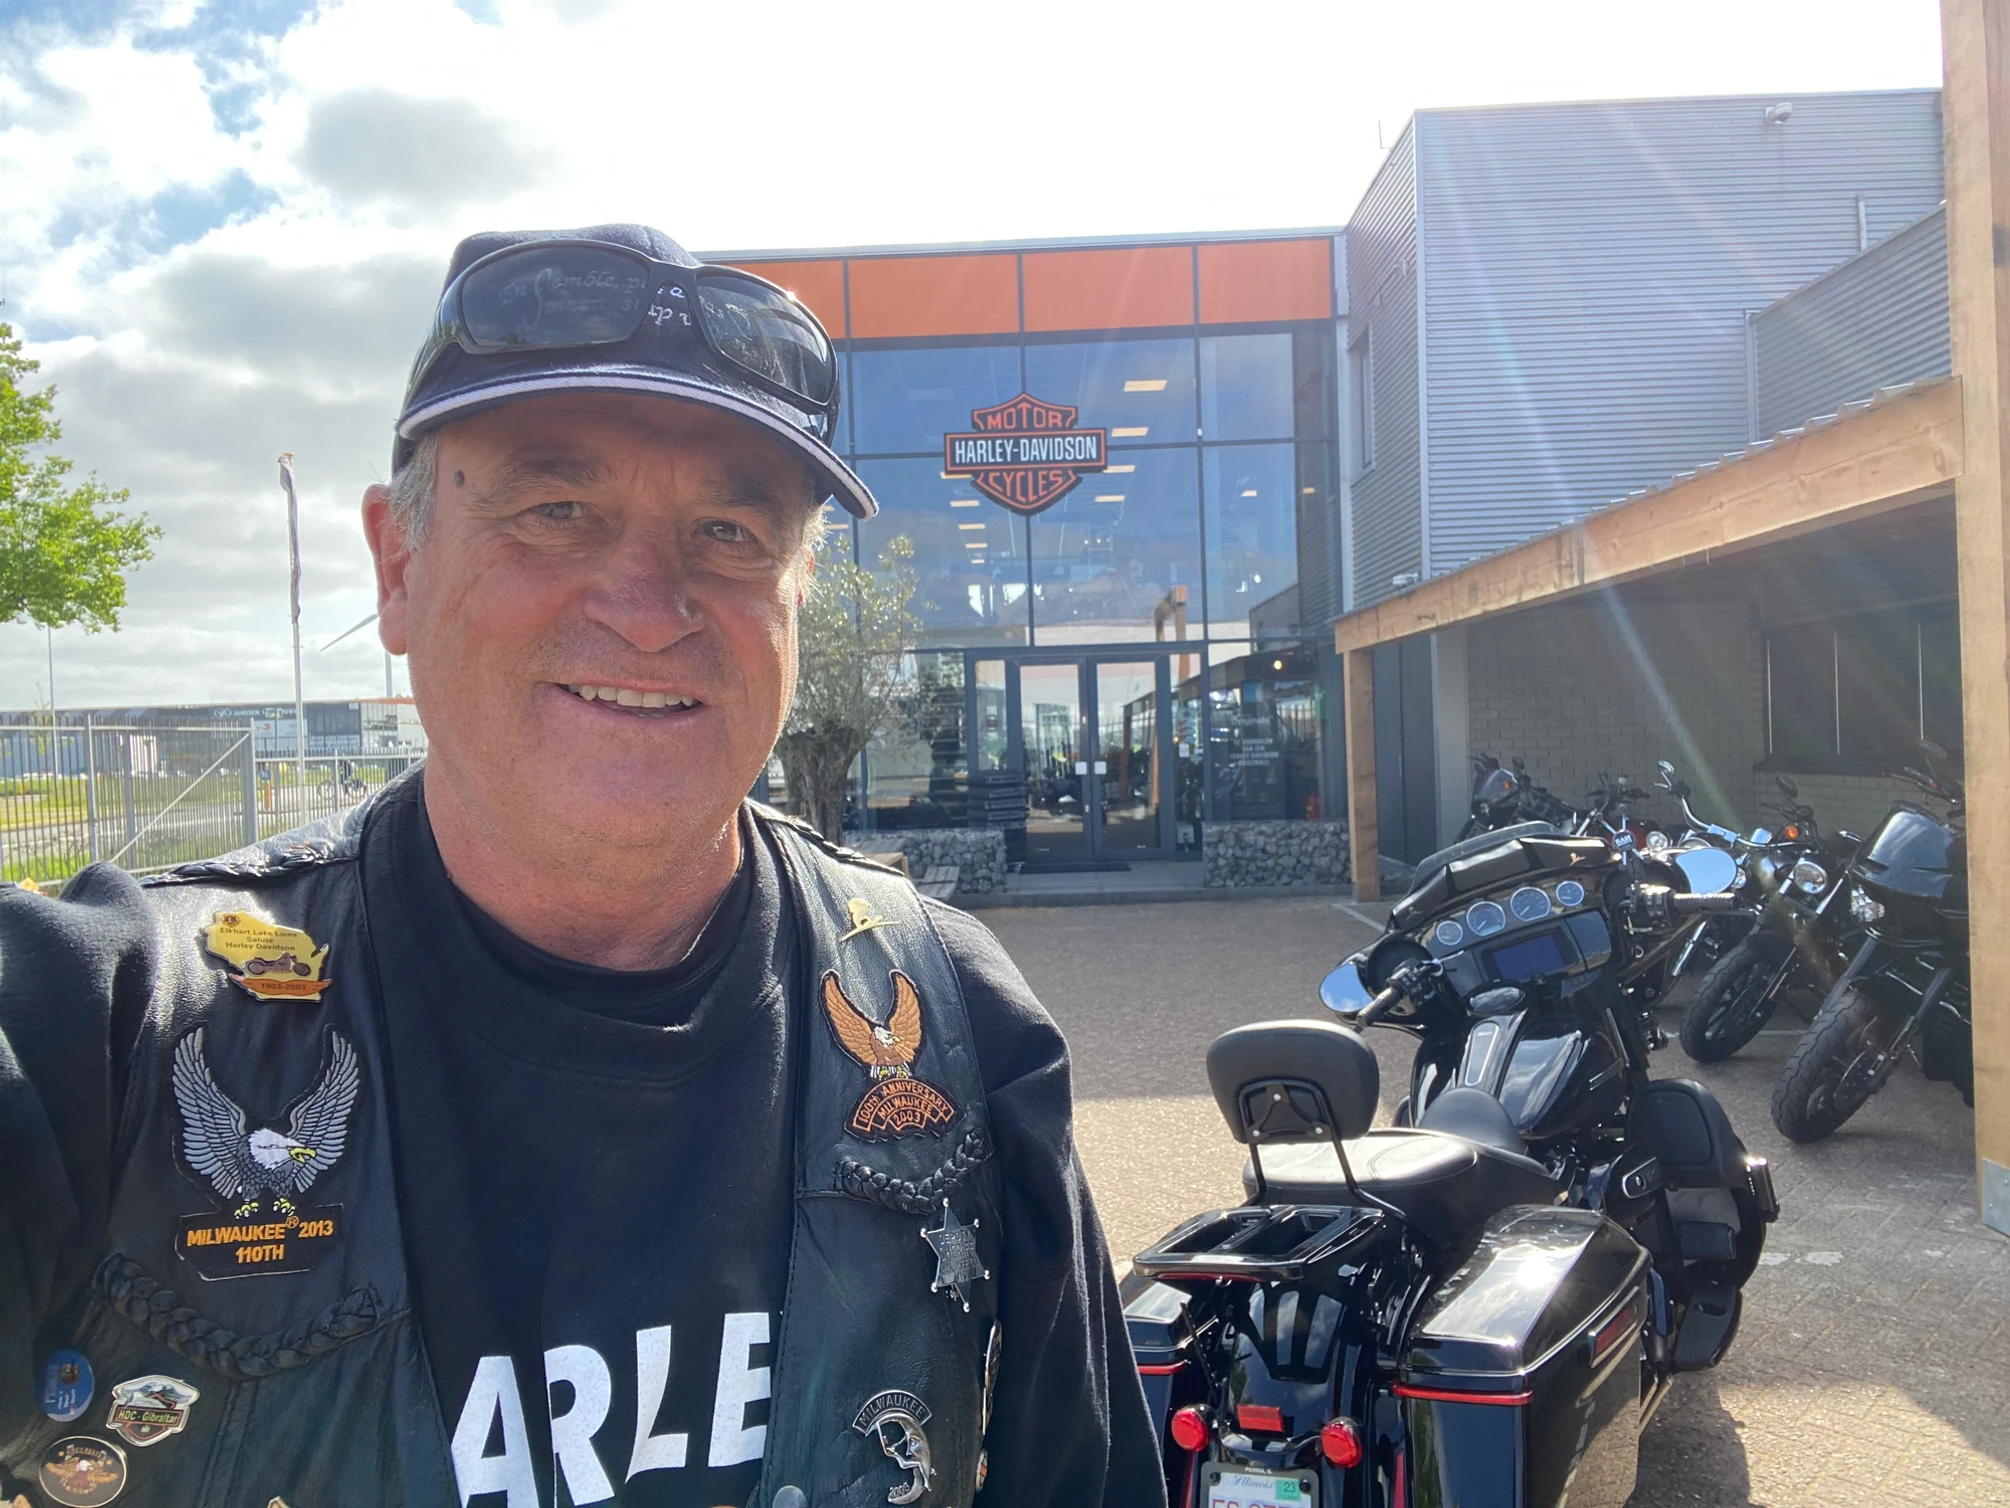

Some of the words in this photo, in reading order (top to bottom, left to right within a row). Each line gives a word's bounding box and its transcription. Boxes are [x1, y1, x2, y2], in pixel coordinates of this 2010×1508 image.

[987, 402, 1062, 430] MOTOR
[955, 436, 1097, 464] HARLEY-DAVIDSON
[988, 470, 1064, 503] CYCLES
[1615, 834, 1633, 847] RAM
[220, 927, 250, 935] Elkhart
[253, 929, 273, 937] Lake
[226, 941, 253, 950] Harley
[256, 943, 296, 951] Davidson
[261, 983, 306, 991] 1903-2003
[882, 1082, 949, 1113] ANNIVERSARY
[877, 1096, 933, 1119] MILWAUKEE
[893, 1111, 921, 1125] 2003
[298, 1220, 334, 1238] 2013
[235, 1245, 285, 1264] 110TH
[118, 1410, 137, 1421] HDC
[142, 1411, 178, 1424] Gibraltar
[858, 1394, 926, 1427] MILWAUKEE
[1230, 1475, 1274, 1489] Illinois
[1284, 1481, 1296, 1493] 23
